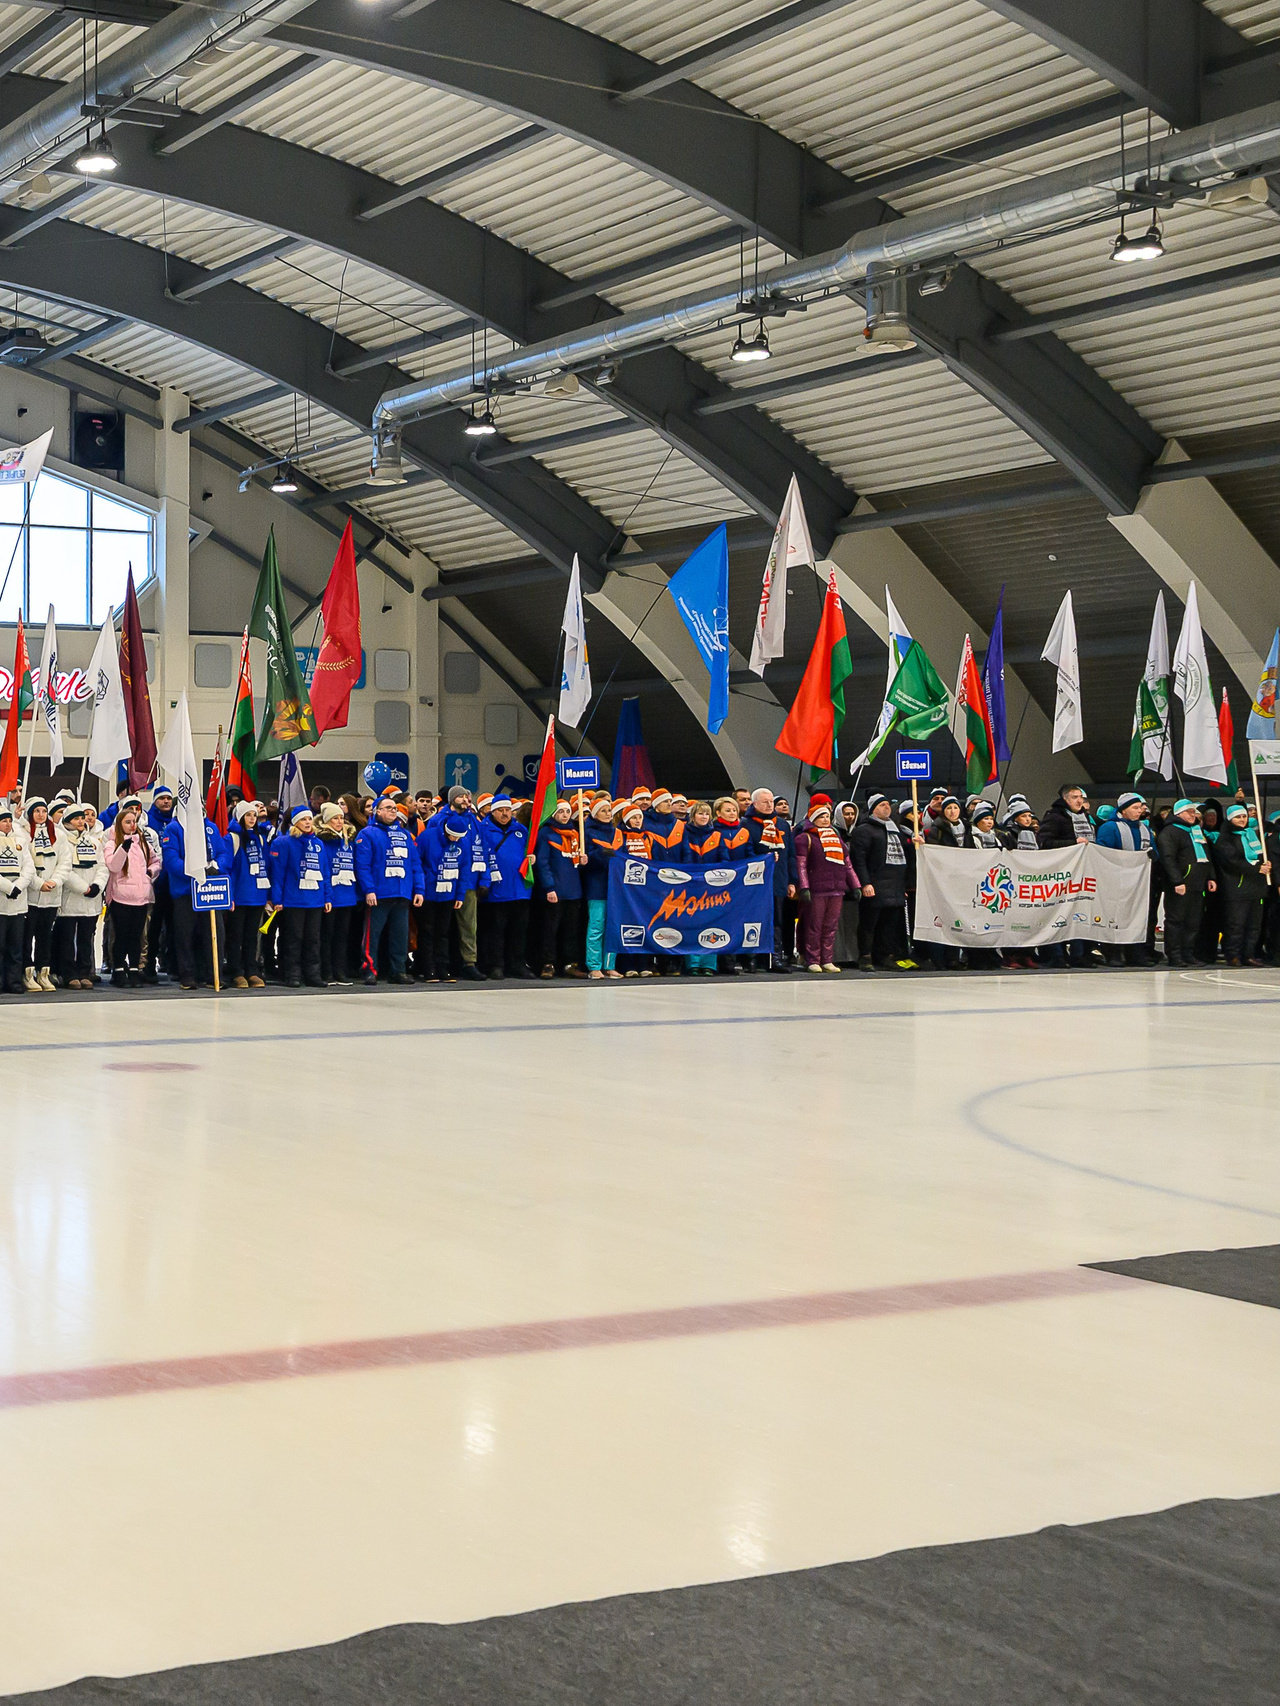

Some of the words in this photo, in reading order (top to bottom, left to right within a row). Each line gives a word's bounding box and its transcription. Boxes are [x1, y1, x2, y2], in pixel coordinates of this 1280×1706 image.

[901, 760, 927, 770] Единые
[566, 768, 594, 779] Молния
[1018, 872, 1072, 882] КОМАНДА
[197, 882, 227, 893] Академия
[1018, 877, 1097, 902] ЕДИНЫЕ
[200, 892, 225, 903] сервиса
